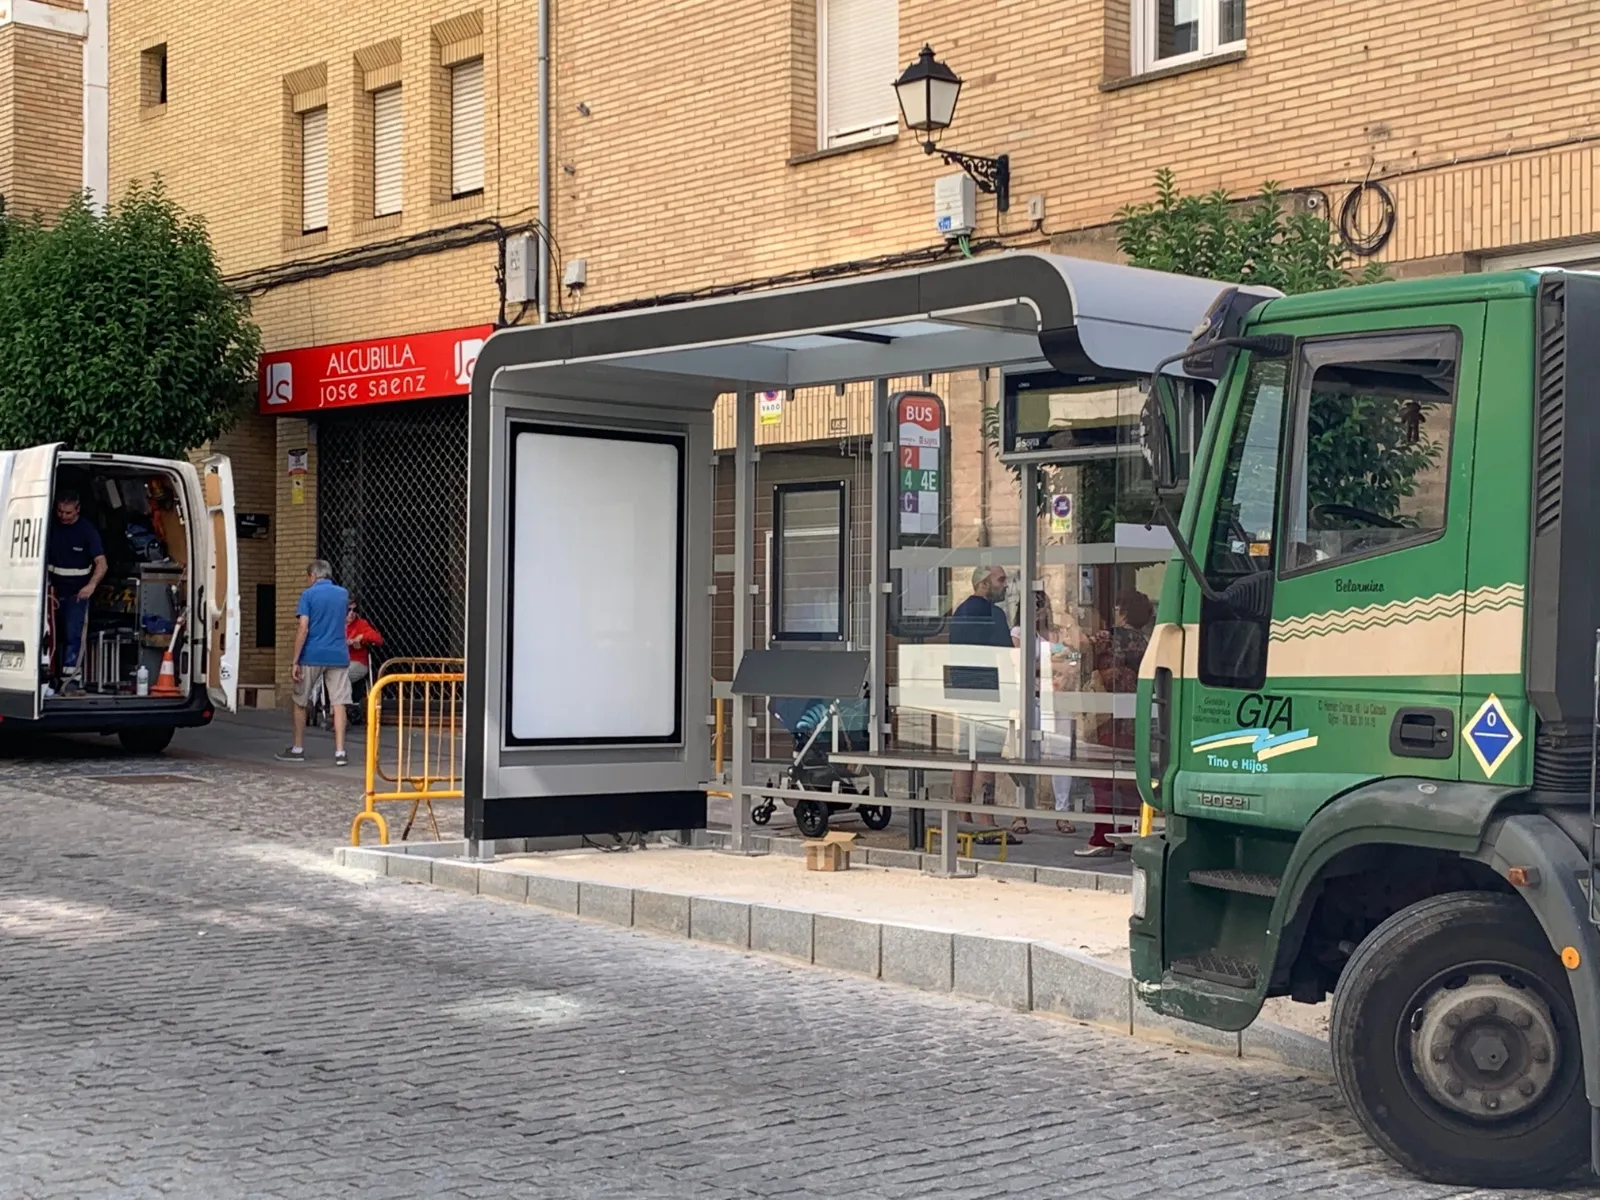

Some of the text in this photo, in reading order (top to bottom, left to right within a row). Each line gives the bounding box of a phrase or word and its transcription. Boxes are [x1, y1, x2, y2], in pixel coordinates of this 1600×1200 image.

[326, 343, 416, 377] ALCUBILLA
[368, 374, 426, 398] saenz
[905, 405, 933, 421] BUS
[904, 448, 913, 468] 2
[904, 469, 937, 491] 4 4E
[904, 491, 913, 512] C
[1334, 578, 1385, 593] Belarmino
[1236, 692, 1293, 732] GTA
[1486, 711, 1497, 727] 0
[1207, 754, 1269, 774] Tino e Hijos
